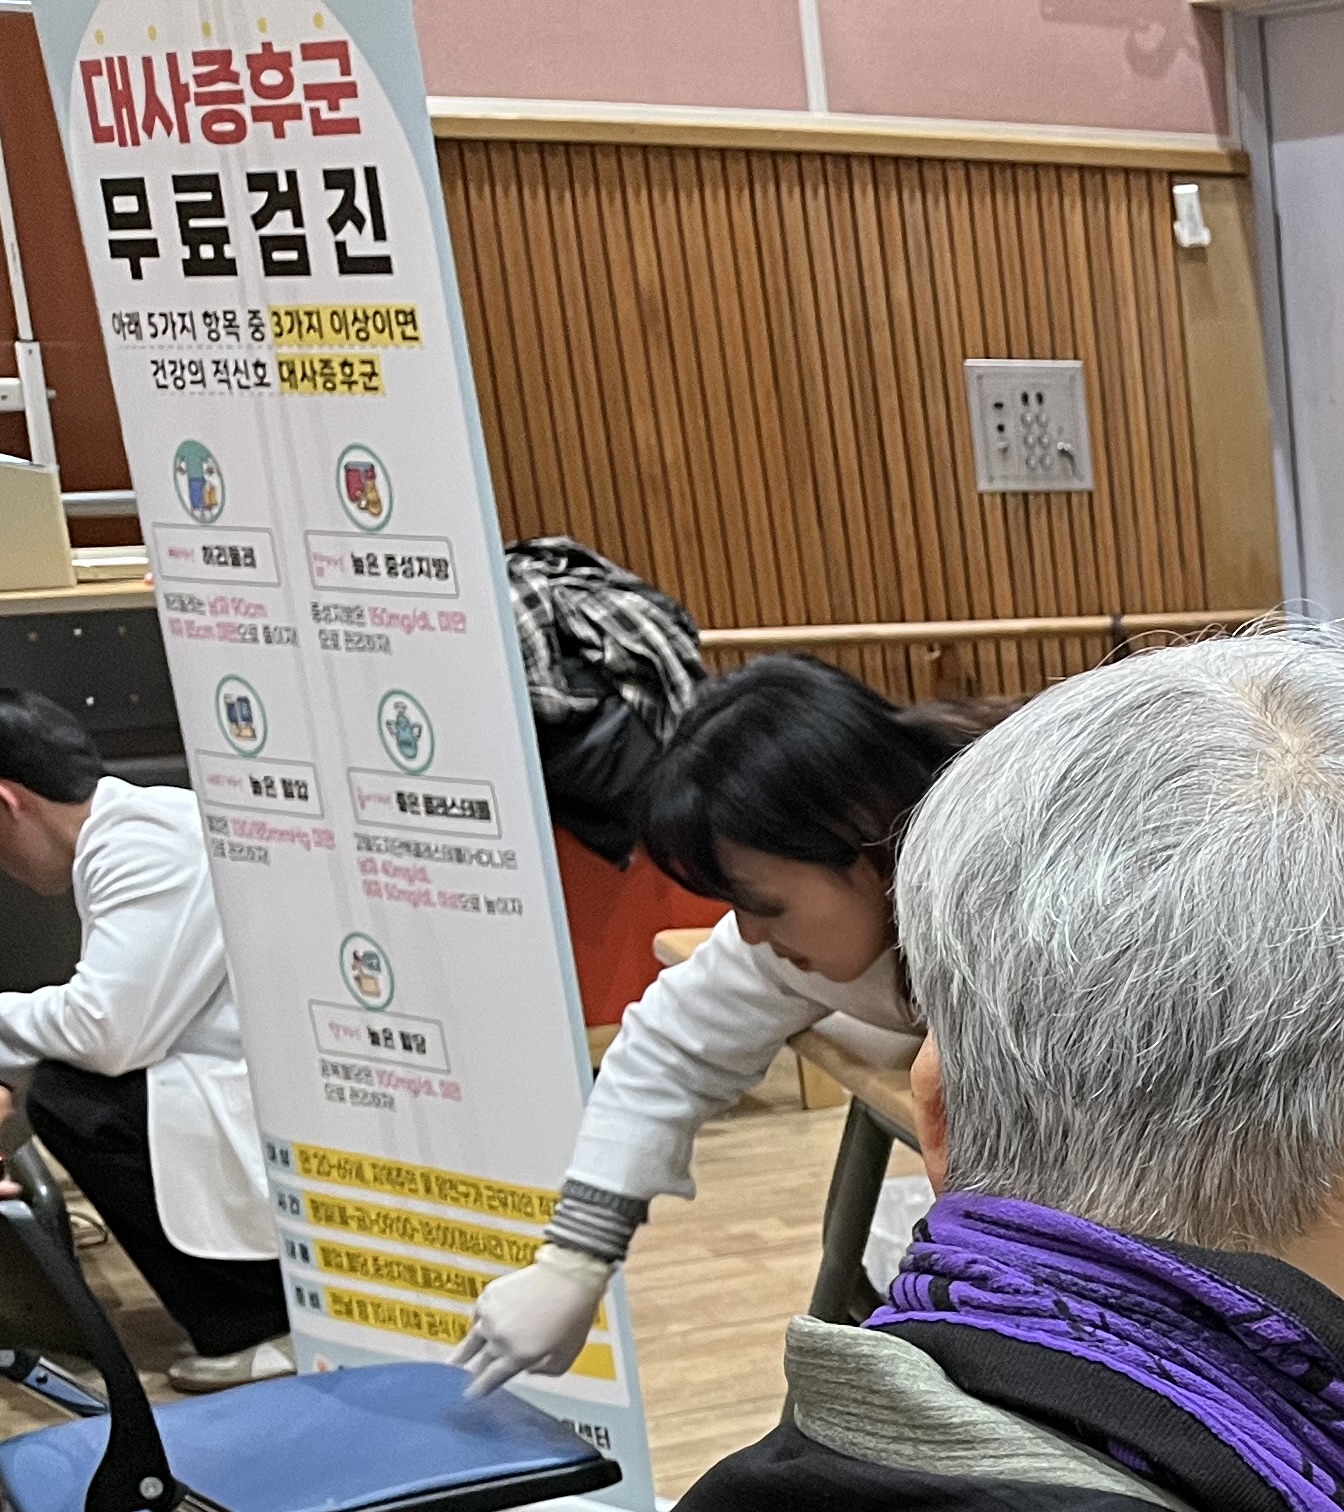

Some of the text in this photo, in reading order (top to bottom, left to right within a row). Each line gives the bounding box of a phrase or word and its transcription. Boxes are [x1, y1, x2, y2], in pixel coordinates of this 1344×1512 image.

[80, 40, 361, 147] 대사증후군
[100, 166, 393, 280] 무료검진
[111, 311, 418, 341] 아래 5가지 항목 중 3가지 이상이면
[151, 358, 380, 392] 건강의 적신호 대사증후군
